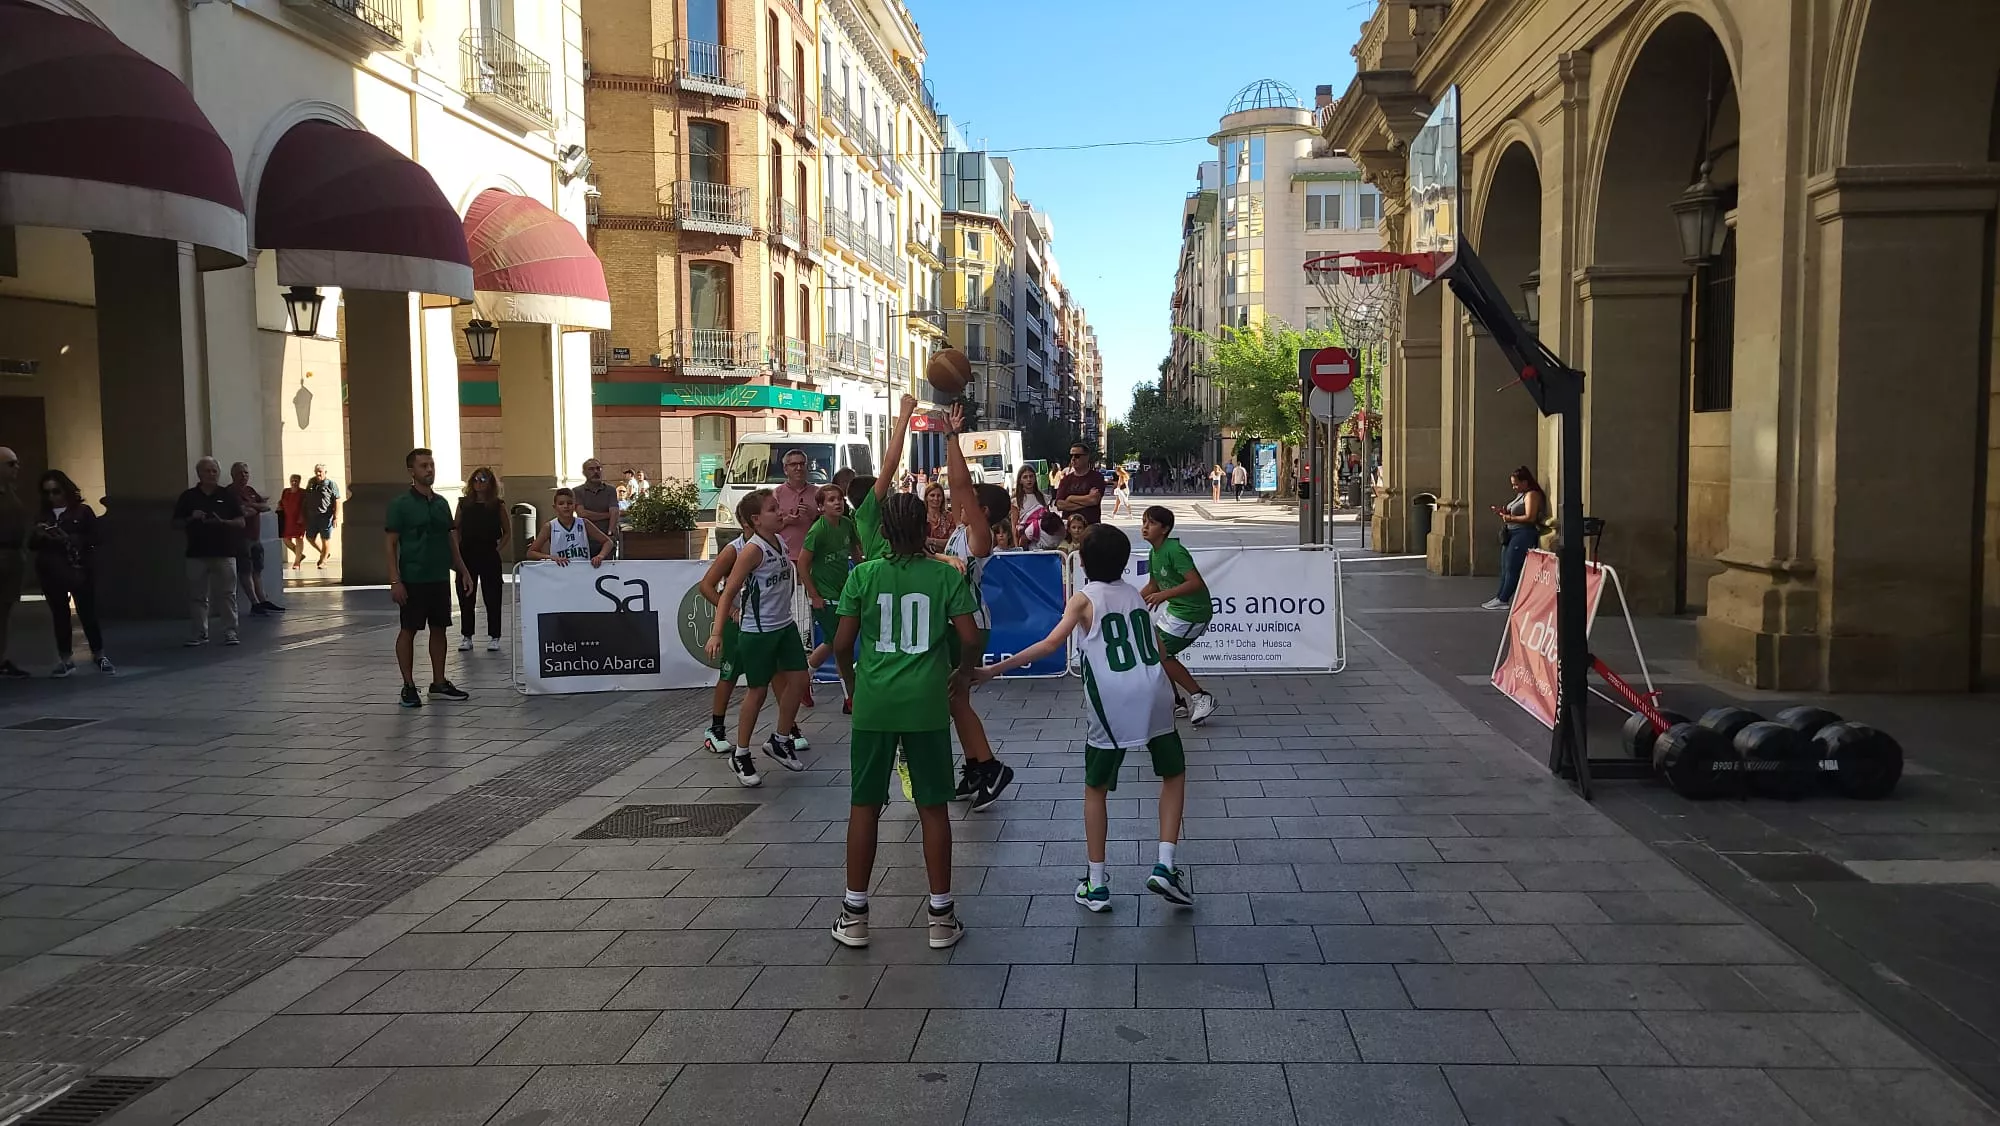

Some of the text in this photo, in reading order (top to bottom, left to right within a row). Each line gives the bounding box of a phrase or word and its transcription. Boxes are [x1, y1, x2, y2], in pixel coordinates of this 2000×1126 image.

[1230, 430, 1267, 439] MGO
[1210, 596, 1325, 615] as anoro
[875, 592, 930, 654] 10
[1206, 620, 1301, 632] ABORAL Y JURÍDICA
[1101, 608, 1160, 672] 80
[1262, 640, 1292, 648] Huesca
[545, 641, 577, 653] Hotel
[1203, 652, 1282, 661] www.rivasanoro.com
[544, 655, 655, 672] Sancho Abarca
